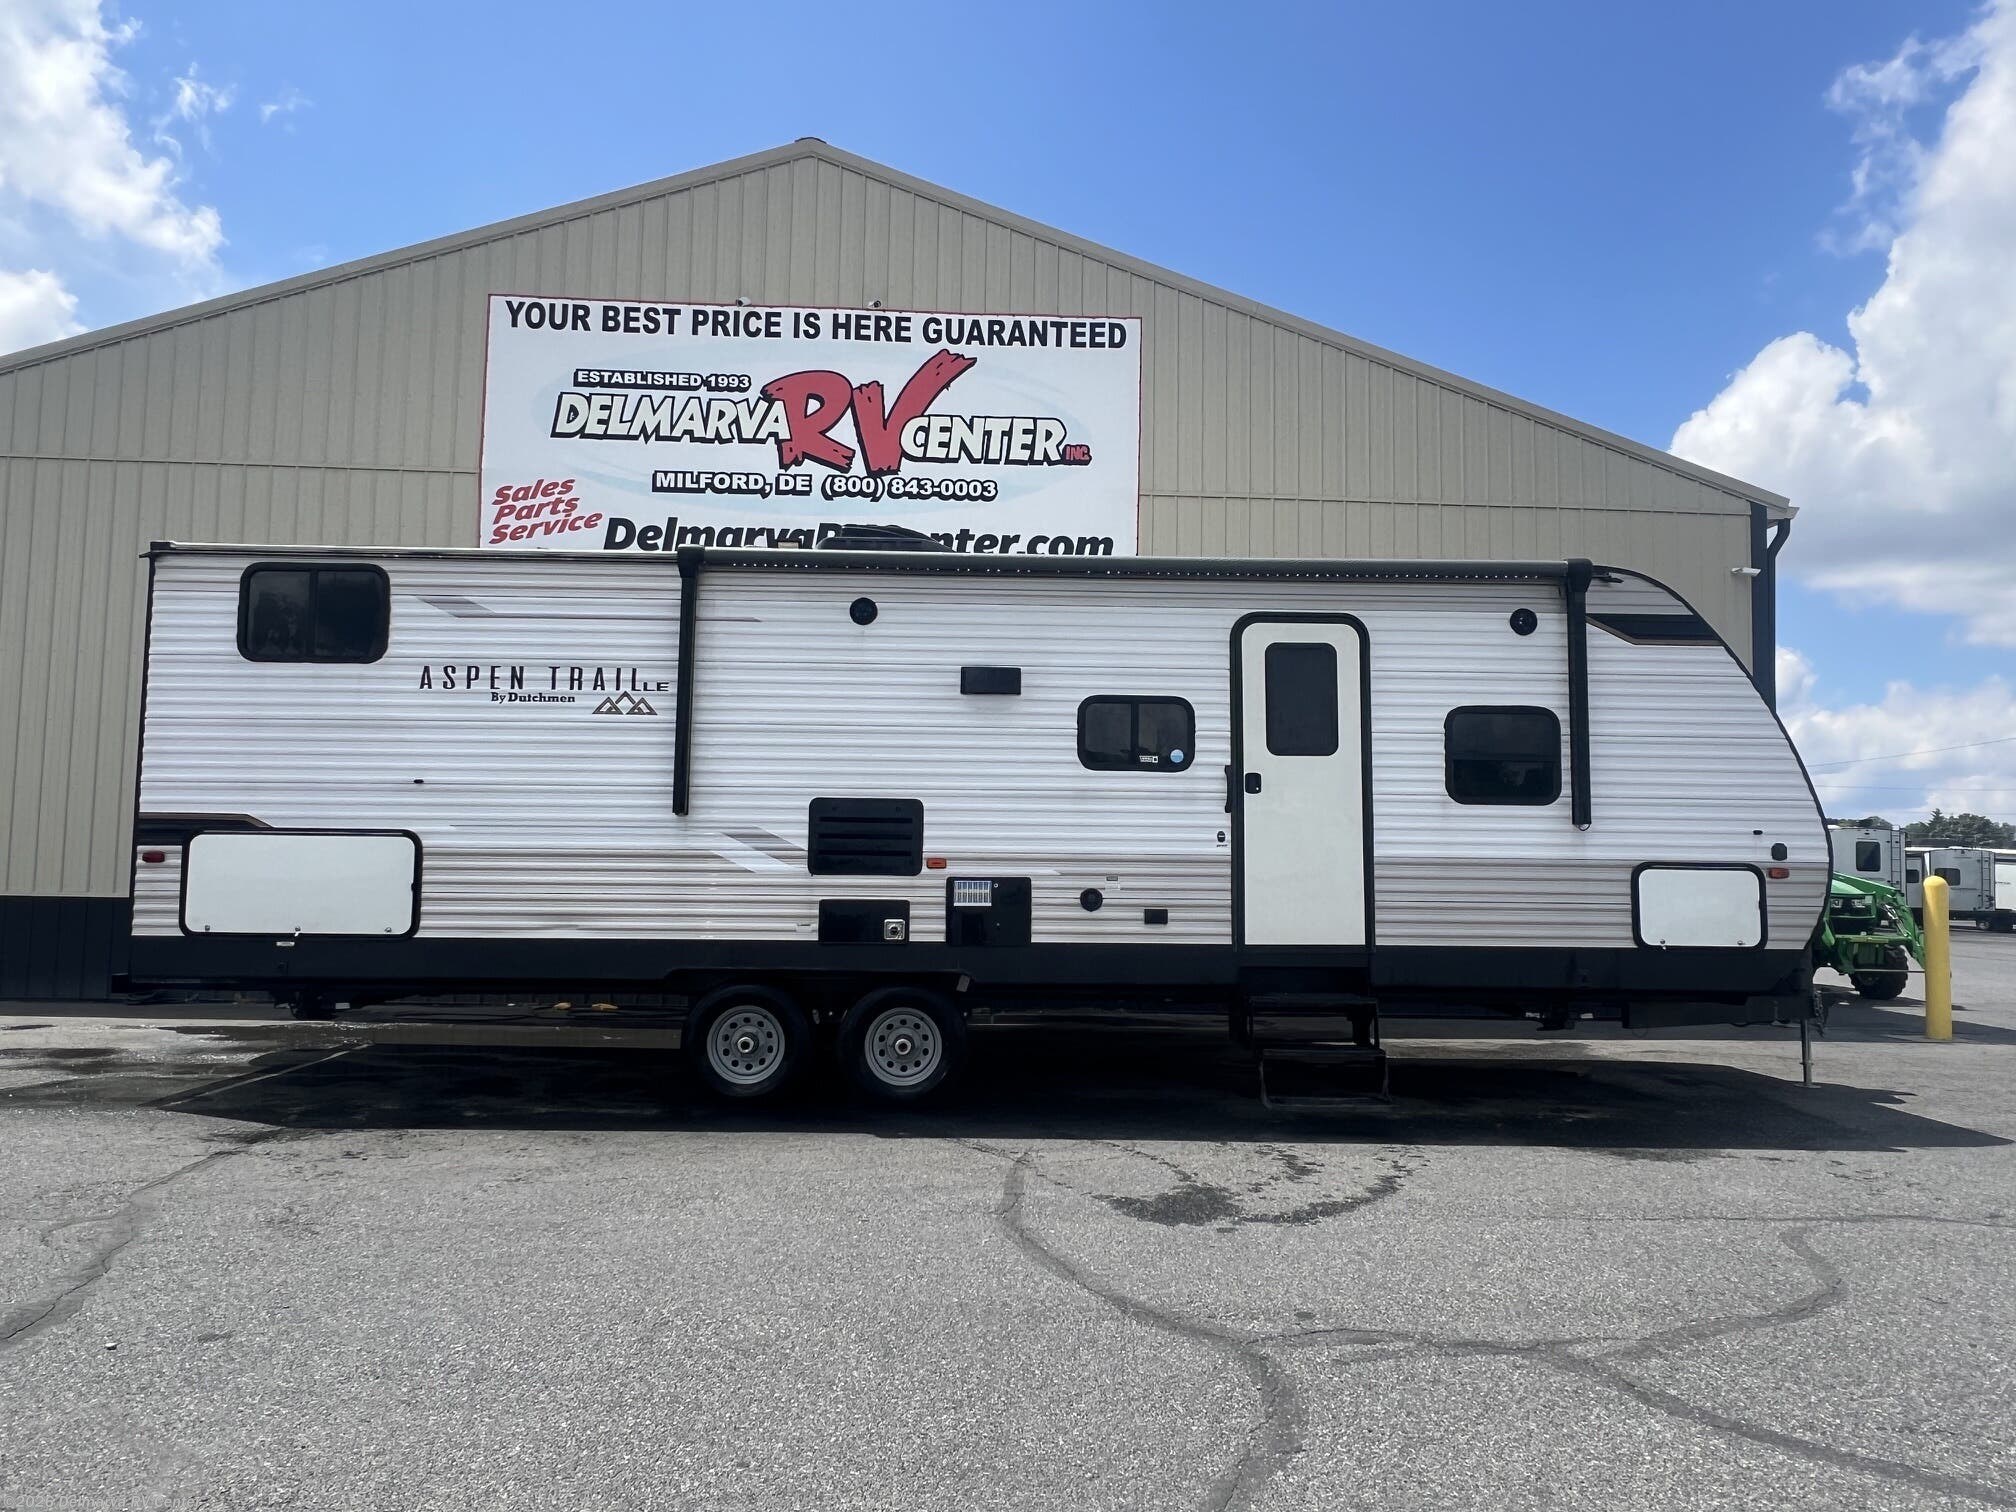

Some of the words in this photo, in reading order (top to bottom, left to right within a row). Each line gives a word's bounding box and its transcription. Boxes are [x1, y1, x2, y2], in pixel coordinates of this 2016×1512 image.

[505, 300, 591, 331] YOUR
[601, 305, 681, 335] BEST
[691, 309, 782, 338] PRICE
[793, 312, 821, 339] IS
[832, 313, 912, 342] HERE
[922, 318, 1126, 348] GUARANTEED
[575, 369, 703, 389] ESTABLISHED
[706, 374, 751, 390] 1993
[551, 392, 792, 443] DELMARVA
[761, 349, 977, 475] RV
[900, 414, 1067, 465] CENTER
[492, 479, 576, 505] Sales
[653, 470, 773, 498] MILFORD,
[776, 474, 812, 496] DE
[822, 475, 885, 500] (800)
[889, 475, 998, 500] 843-0003
[493, 497, 580, 524] Parts
[489, 512, 603, 544] Service
[603, 517, 1114, 556] Delmarvanter.com
[419, 665, 525, 690] ASPEN
[549, 666, 642, 692] TRAIL
[642, 681, 670, 692] LE
[490, 692, 507, 704] By
[508, 692, 576, 704] Dutchmen
